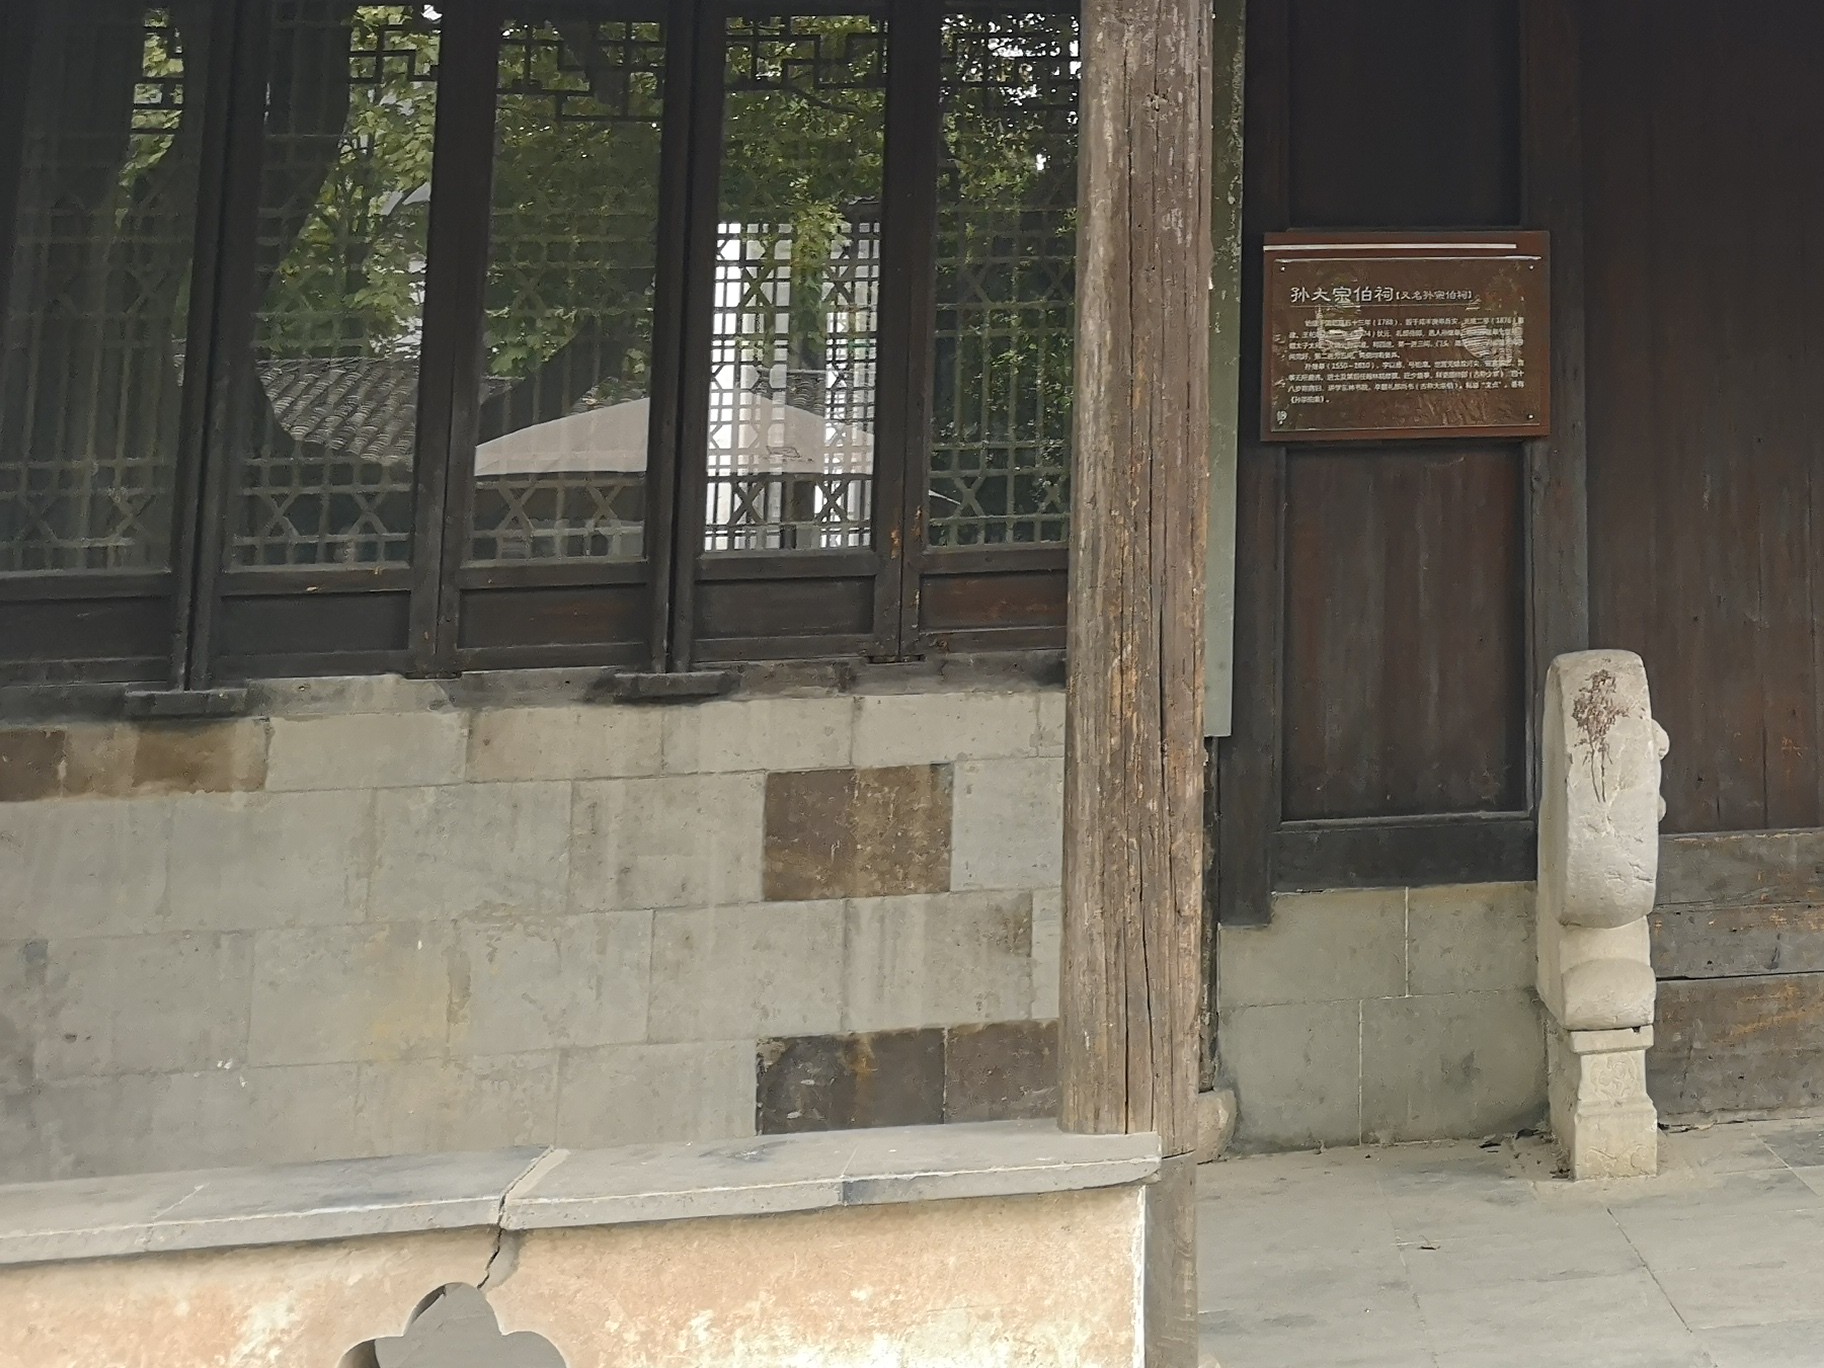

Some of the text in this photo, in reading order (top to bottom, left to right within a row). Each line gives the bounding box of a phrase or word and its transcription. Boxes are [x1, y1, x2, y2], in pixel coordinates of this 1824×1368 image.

[1289, 285, 1394, 303] 孙大宗伯祠
